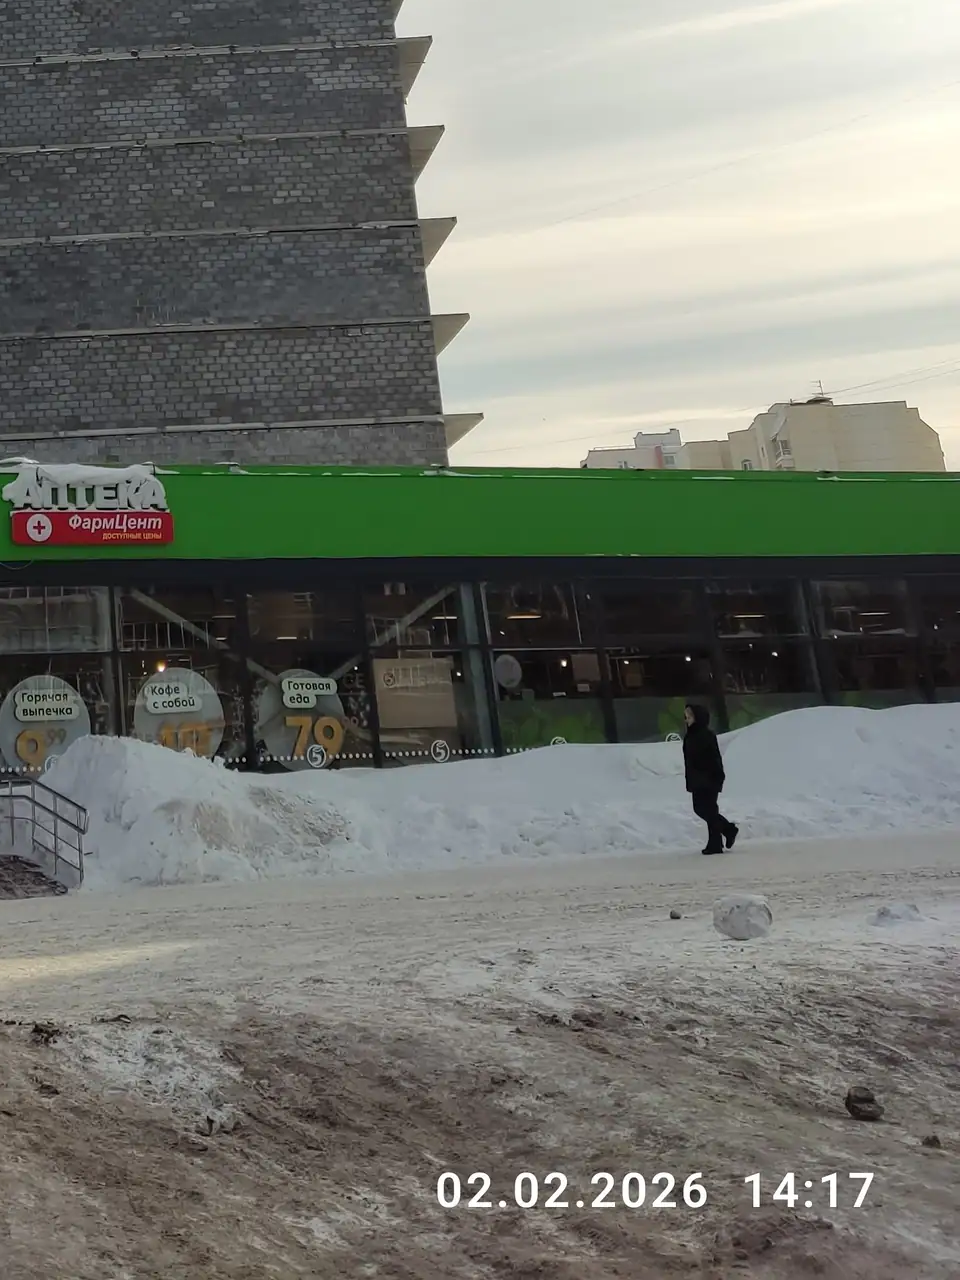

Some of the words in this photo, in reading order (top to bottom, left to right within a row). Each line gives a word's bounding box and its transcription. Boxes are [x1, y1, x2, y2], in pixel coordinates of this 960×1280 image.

[13, 481, 169, 510] АПТЕКА
[69, 514, 162, 533] ФармЦент
[151, 684, 180, 696] Кофе
[287, 681, 331, 691] Готовая
[21, 692, 68, 704] Горячая
[152, 701, 159, 709] с
[162, 696, 195, 709] собой
[289, 693, 310, 704] еда
[22, 707, 73, 717] выпечка
[284, 715, 344, 761] 79
